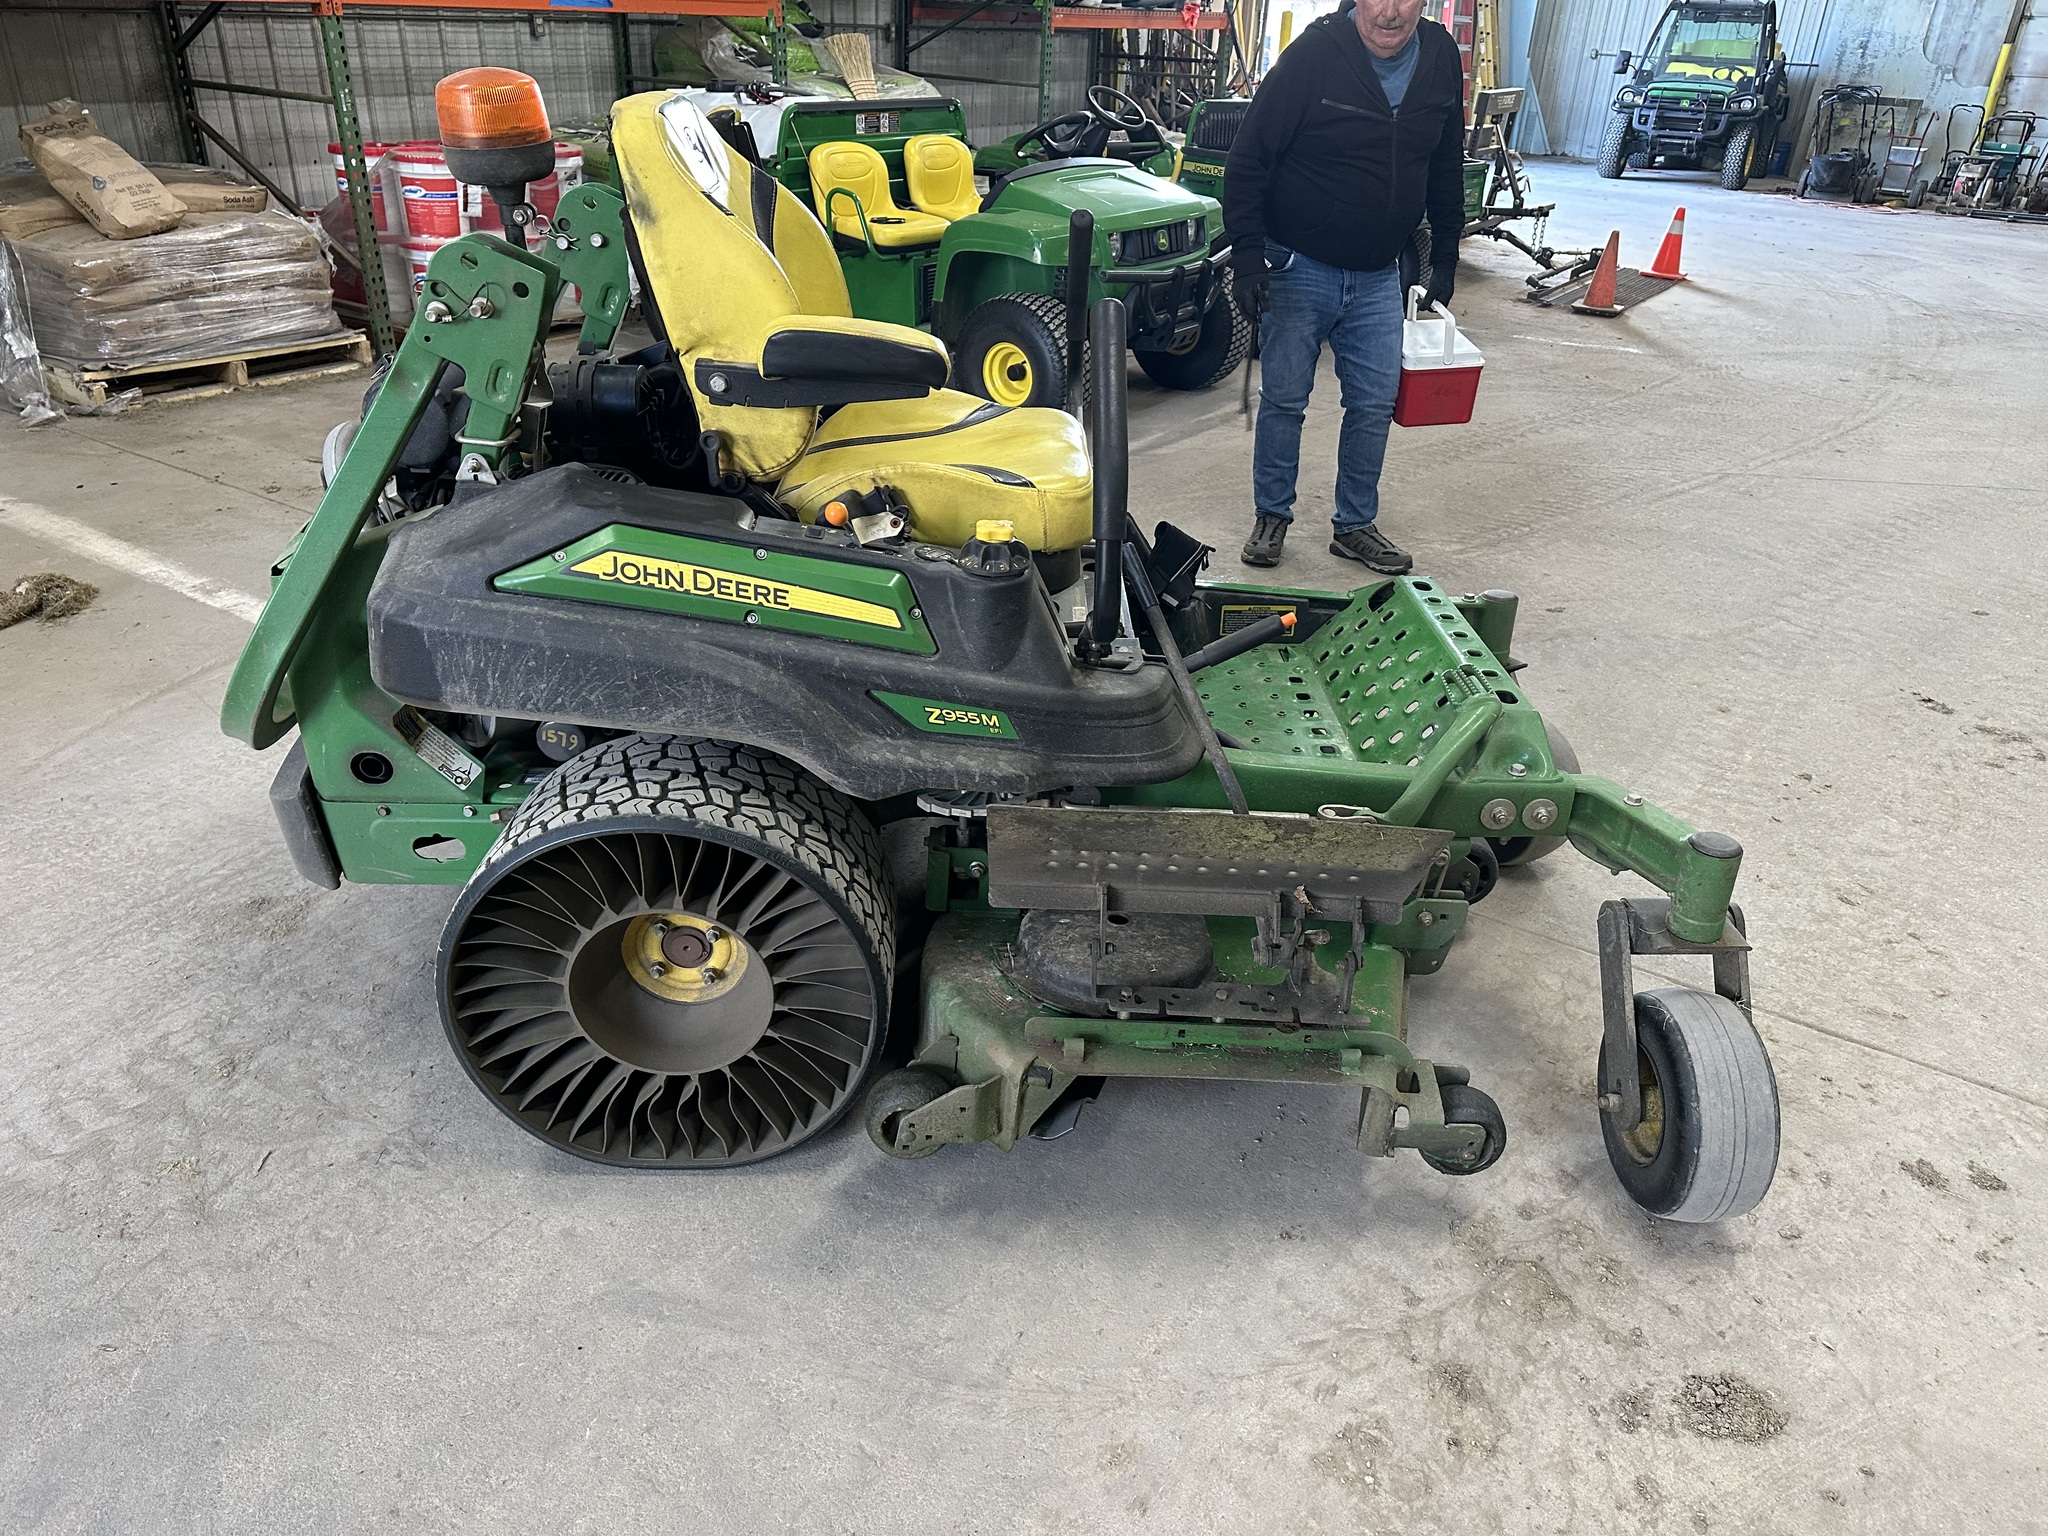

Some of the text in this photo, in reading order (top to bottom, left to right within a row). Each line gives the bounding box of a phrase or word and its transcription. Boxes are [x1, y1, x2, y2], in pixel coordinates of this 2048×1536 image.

[1193, 164, 1212, 174] JOHN
[223, 196, 241, 204] Soda
[602, 556, 790, 607] JOHN DEERE
[924, 707, 1000, 727] Z955M
[541, 730, 578, 751] 1579
